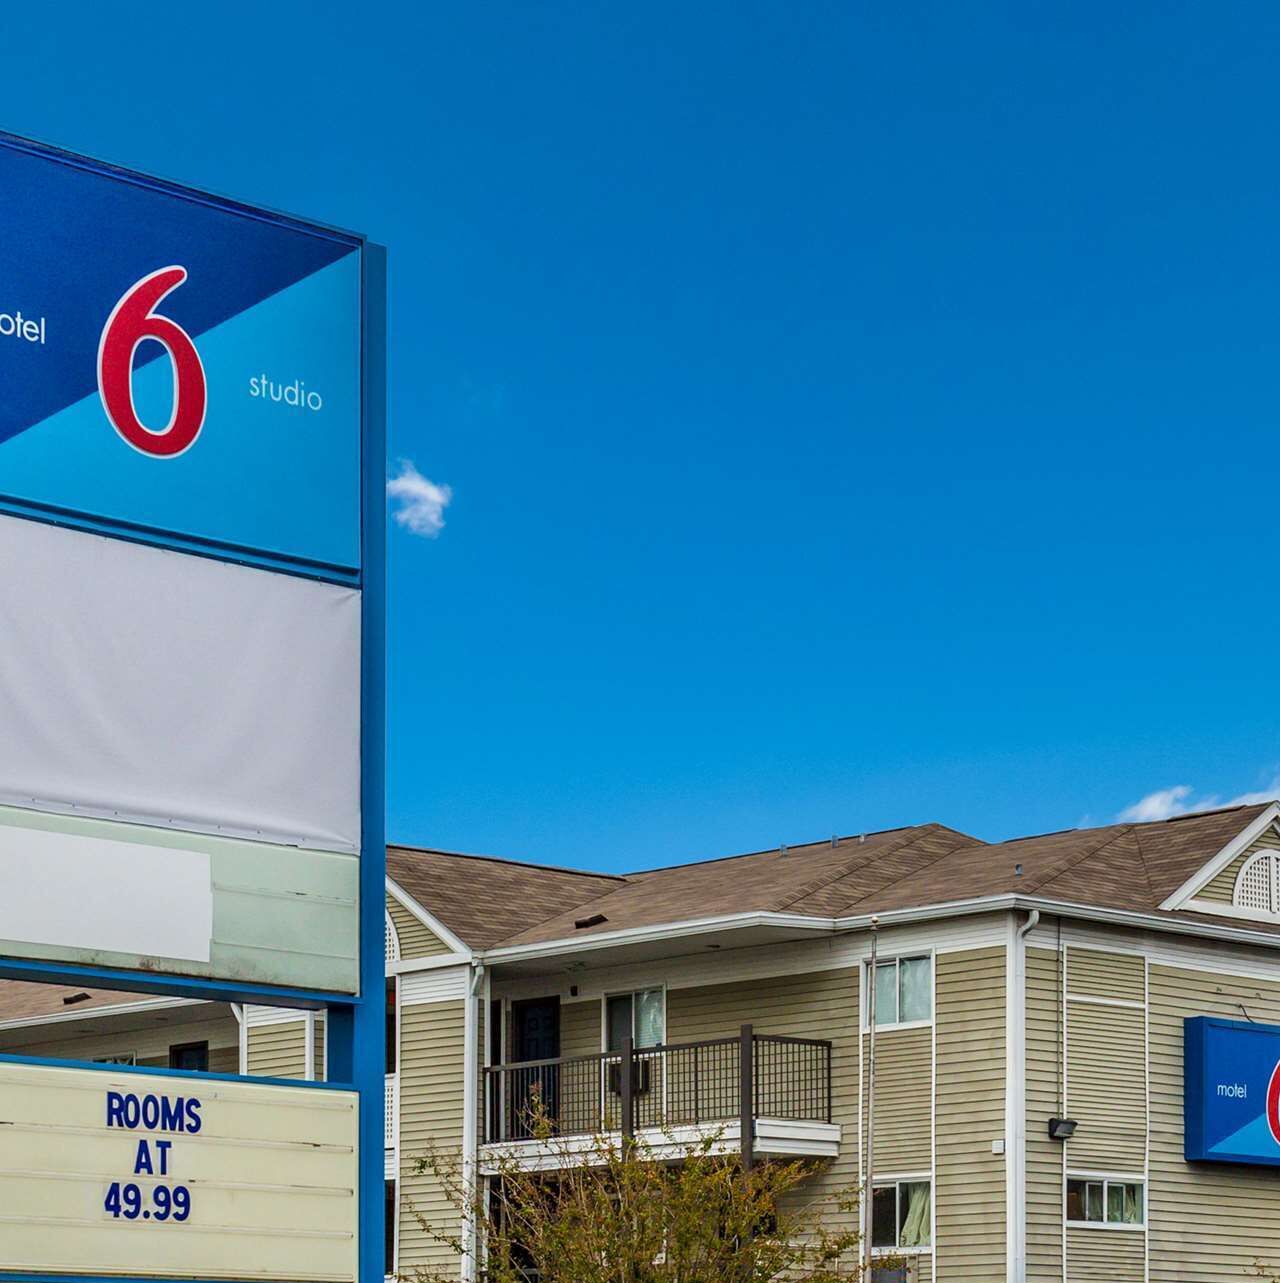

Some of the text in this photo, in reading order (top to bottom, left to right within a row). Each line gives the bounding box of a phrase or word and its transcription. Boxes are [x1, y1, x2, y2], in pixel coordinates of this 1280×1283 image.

[97, 264, 207, 459] 6
[249, 374, 322, 411] studio
[1217, 1083, 1247, 1099] motel
[107, 1091, 201, 1134] ROOMS
[134, 1139, 172, 1176] AT
[104, 1182, 191, 1222] 49.99
